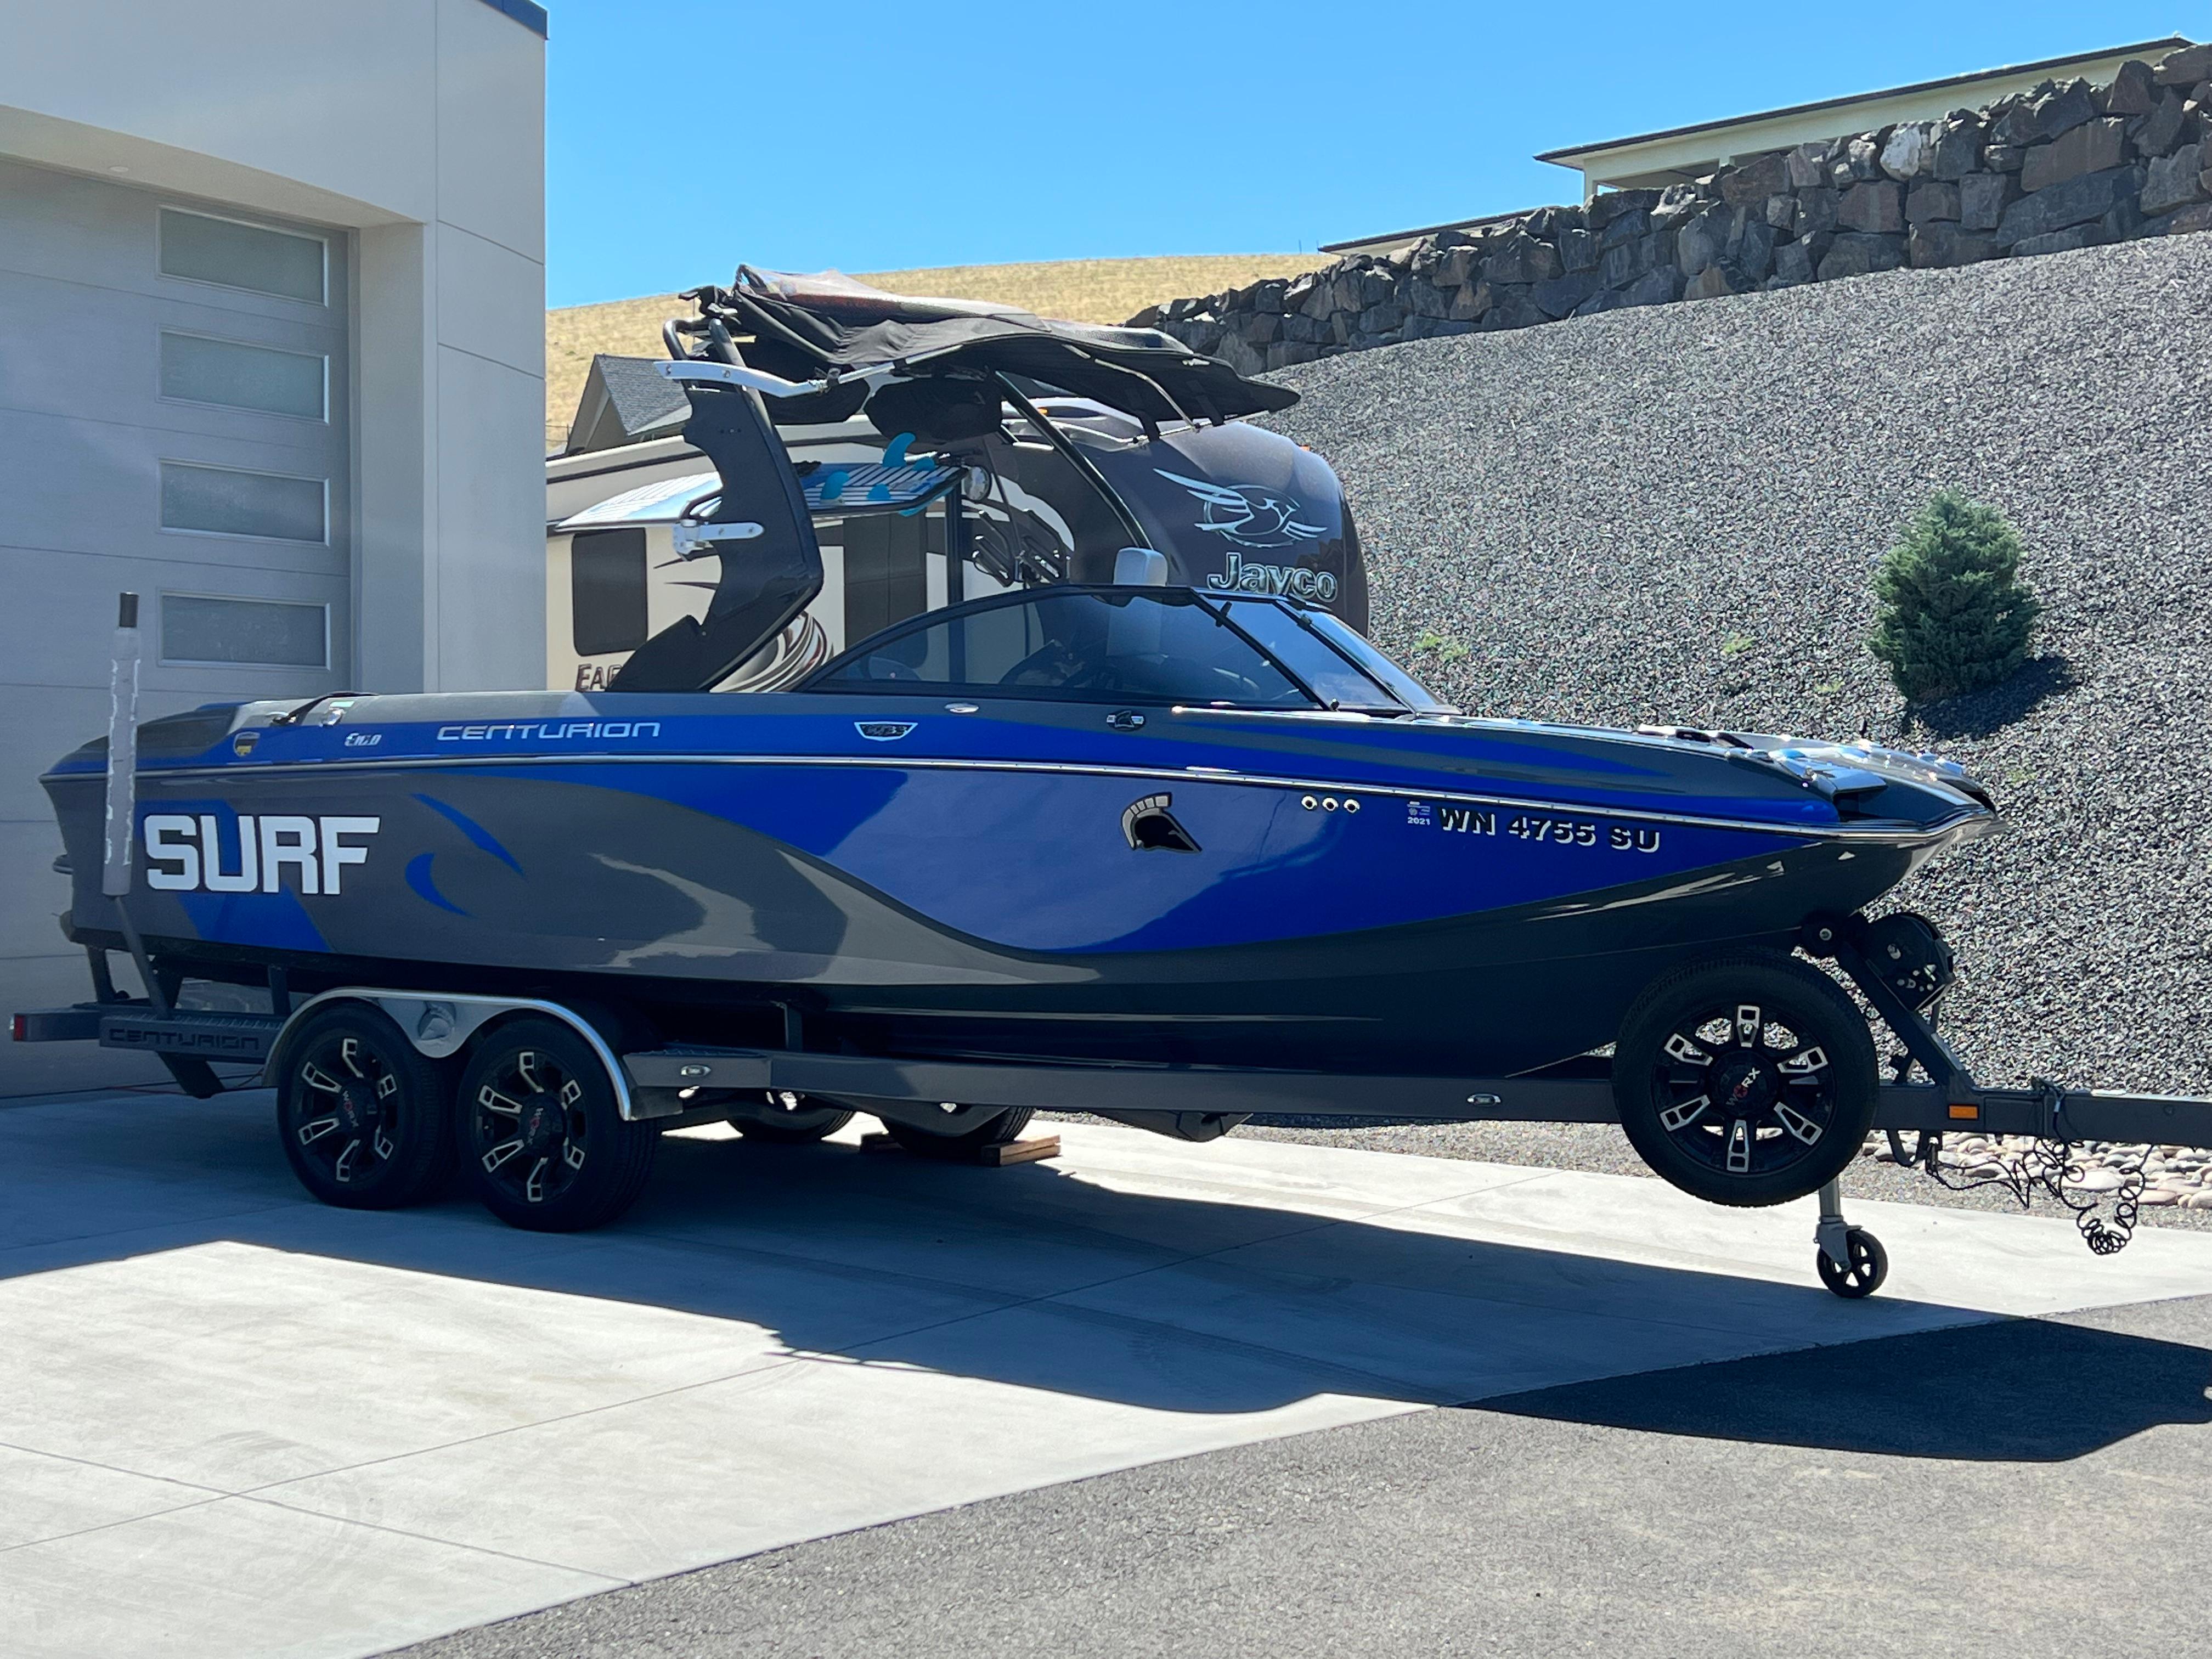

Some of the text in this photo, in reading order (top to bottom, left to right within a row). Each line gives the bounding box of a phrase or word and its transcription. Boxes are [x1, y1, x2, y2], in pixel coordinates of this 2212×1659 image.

[1207, 552, 1338, 602] Jayco
[436, 722, 661, 741] CENTURION
[1407, 816, 1431, 826] 2021
[1438, 808, 1496, 836] WN
[1508, 816, 1596, 847] 4755
[1610, 826, 1660, 853] SU
[144, 814, 381, 895] SURF
[109, 1028, 259, 1050] CENTURION
